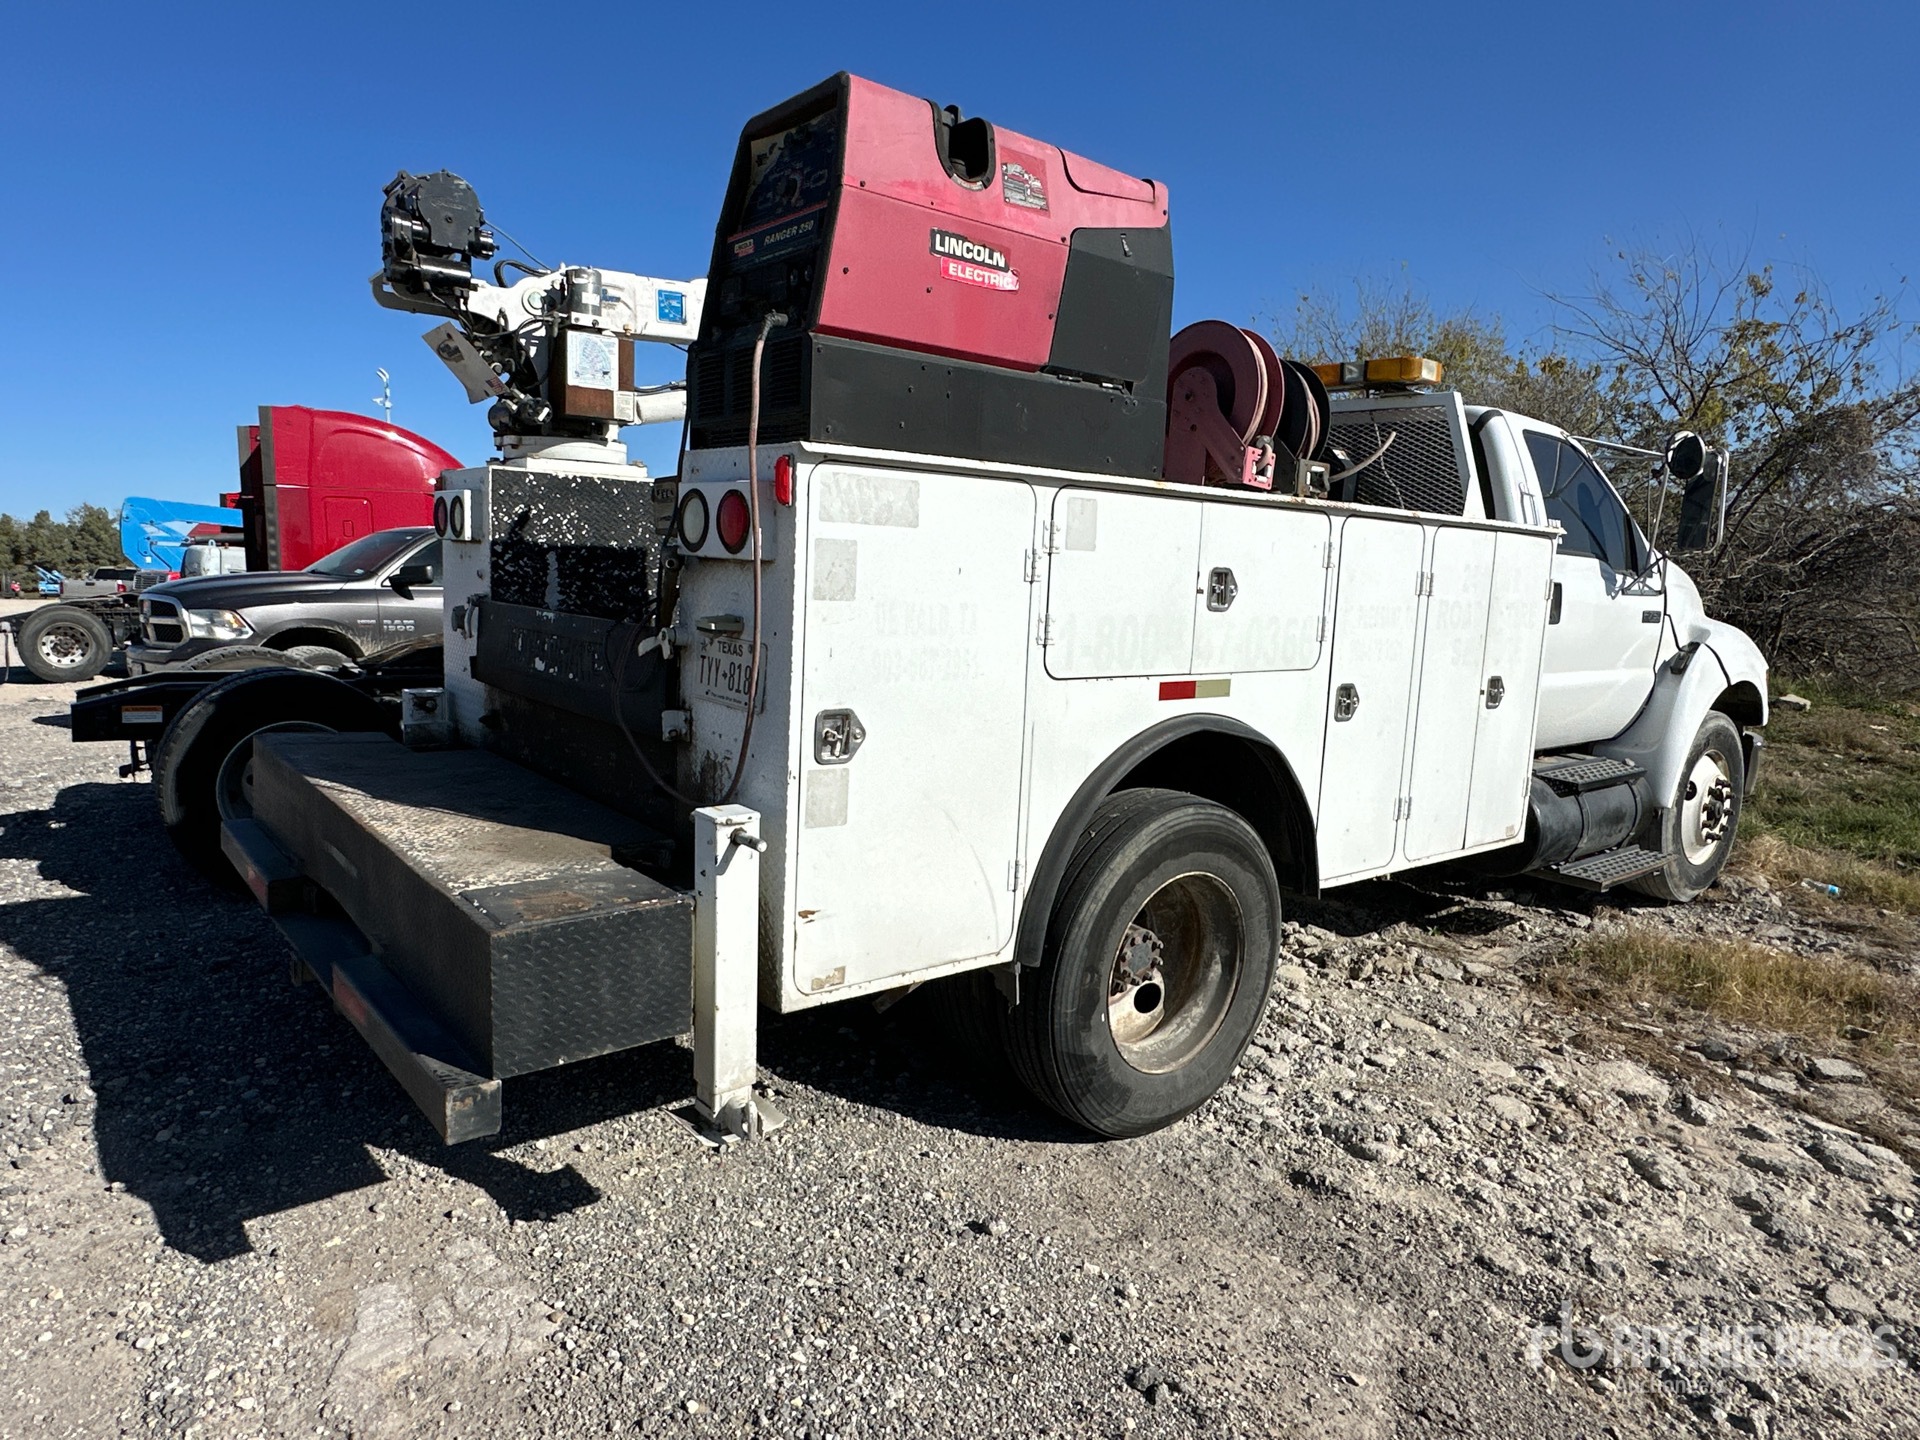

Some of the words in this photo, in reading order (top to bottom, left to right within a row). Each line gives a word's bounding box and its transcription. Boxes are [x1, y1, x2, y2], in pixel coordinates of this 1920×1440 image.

[764, 226, 798, 246] RANGER
[799, 220, 814, 234] 250
[935, 233, 1006, 268] LINCOLN
[949, 263, 1013, 288] ELECTRIC
[717, 641, 743, 657] TEXAS
